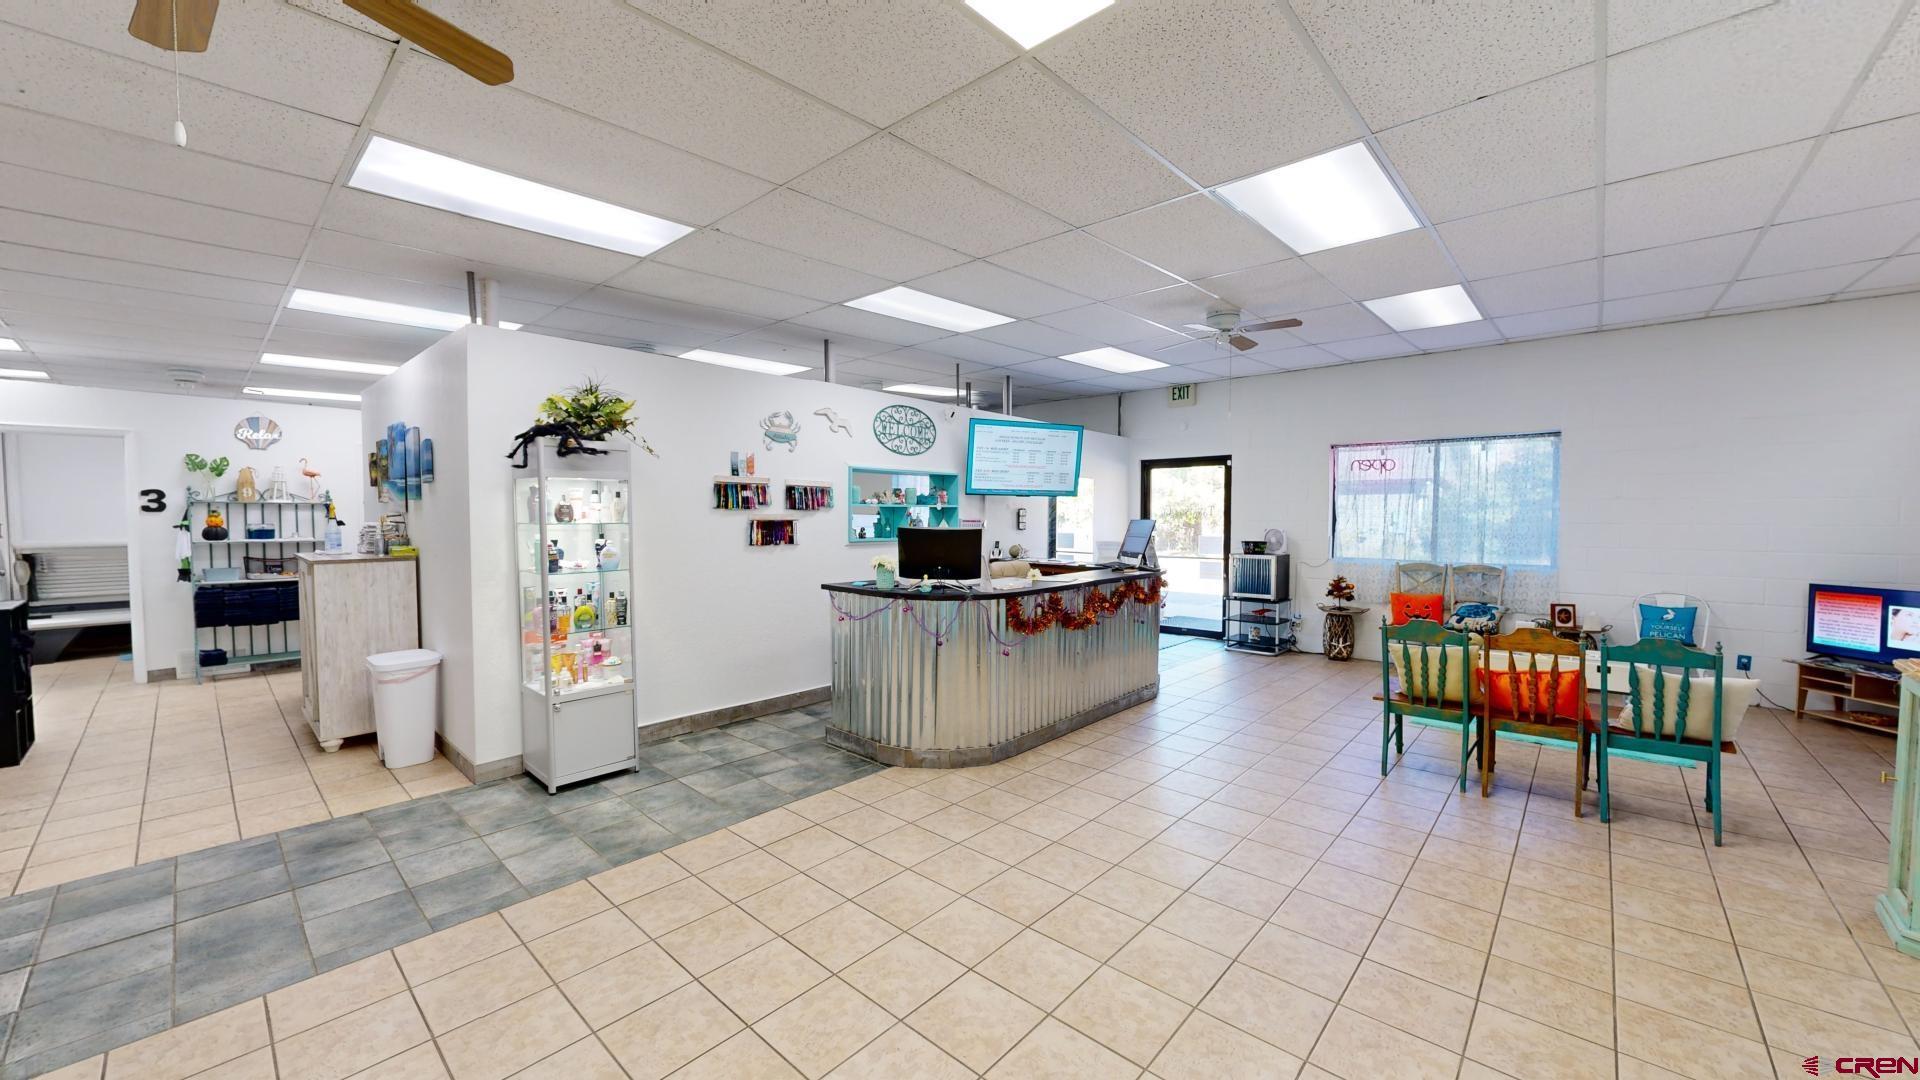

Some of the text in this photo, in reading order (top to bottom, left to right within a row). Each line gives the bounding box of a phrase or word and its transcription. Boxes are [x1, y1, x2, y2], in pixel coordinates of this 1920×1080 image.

[1172, 385, 1191, 401] EXIT
[881, 421, 930, 441] WELCOME
[140, 488, 167, 513] 3
[1649, 631, 1686, 640] PELICAN
[1651, 623, 1686, 632] YOURSELF
